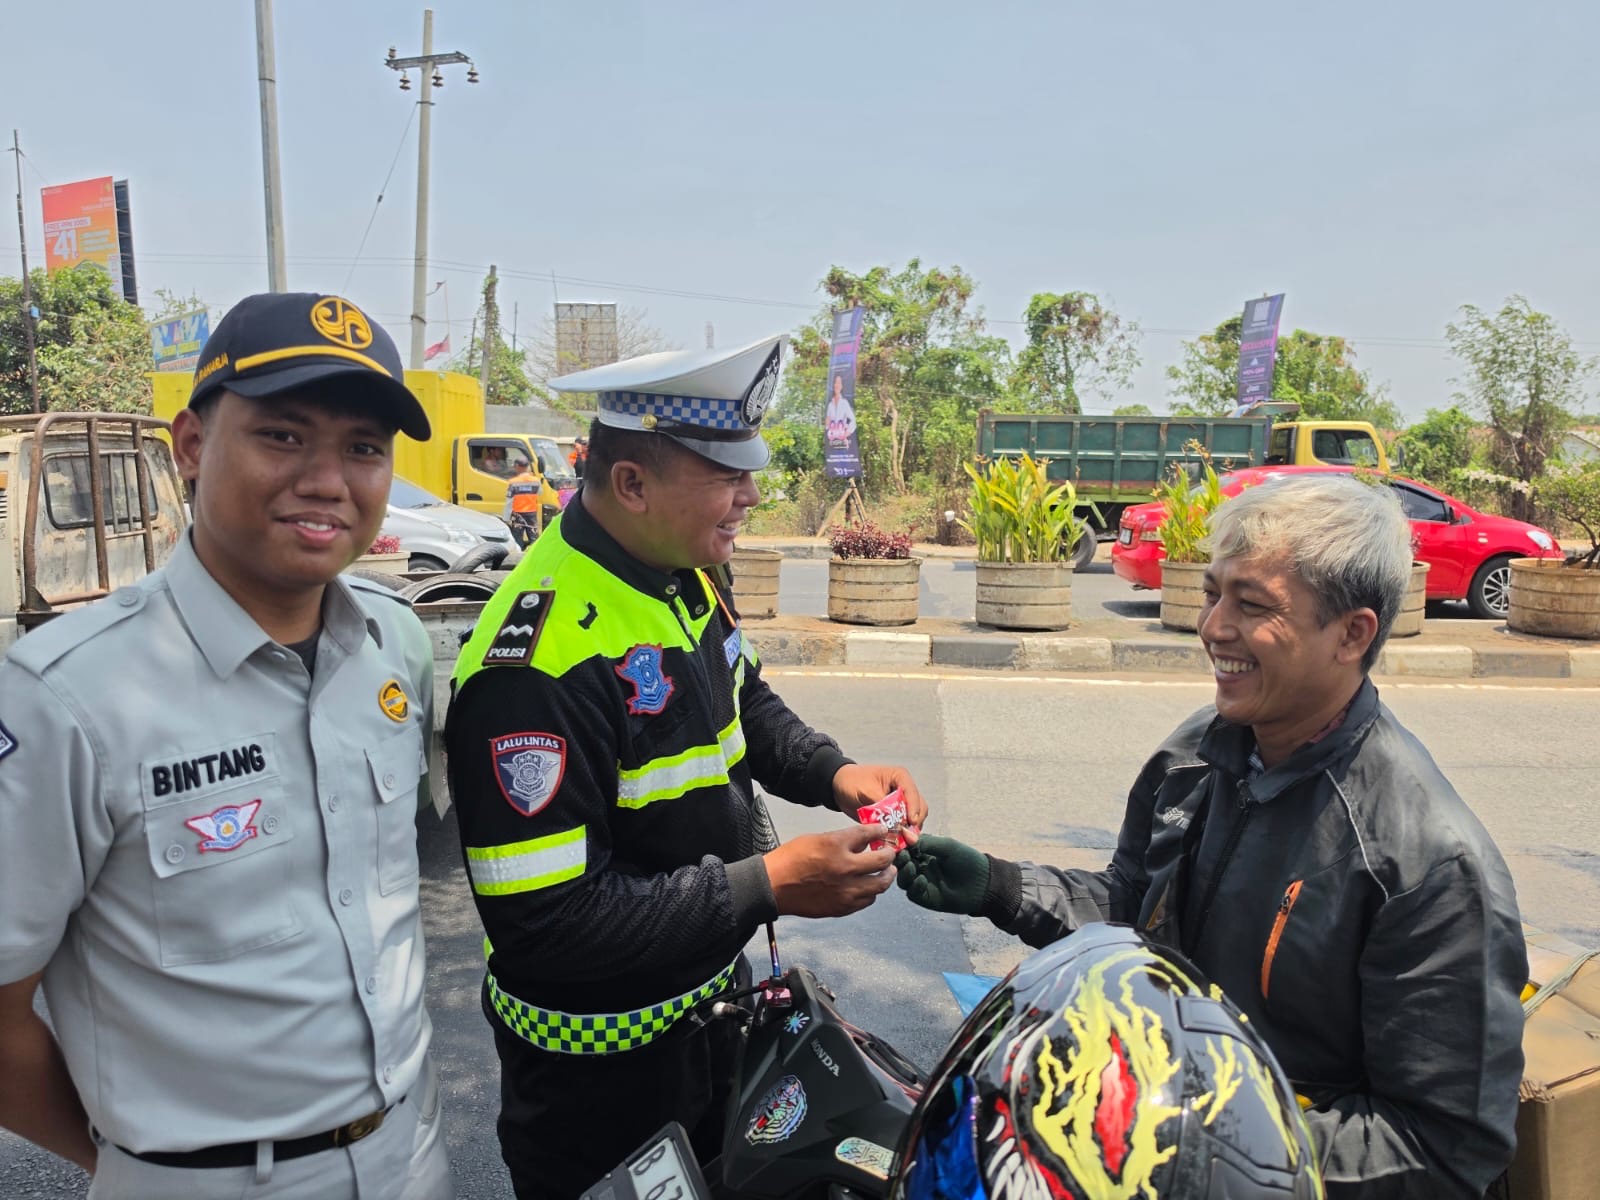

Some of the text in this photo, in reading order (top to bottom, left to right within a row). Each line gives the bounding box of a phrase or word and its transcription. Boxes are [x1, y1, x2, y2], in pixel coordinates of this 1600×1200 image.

[488, 647, 527, 658] POLISI
[497, 736, 559, 751] LALU LINTAS
[152, 744, 266, 797] BINTANG
[811, 1038, 840, 1077] HONDA
[633, 1145, 666, 1176] B
